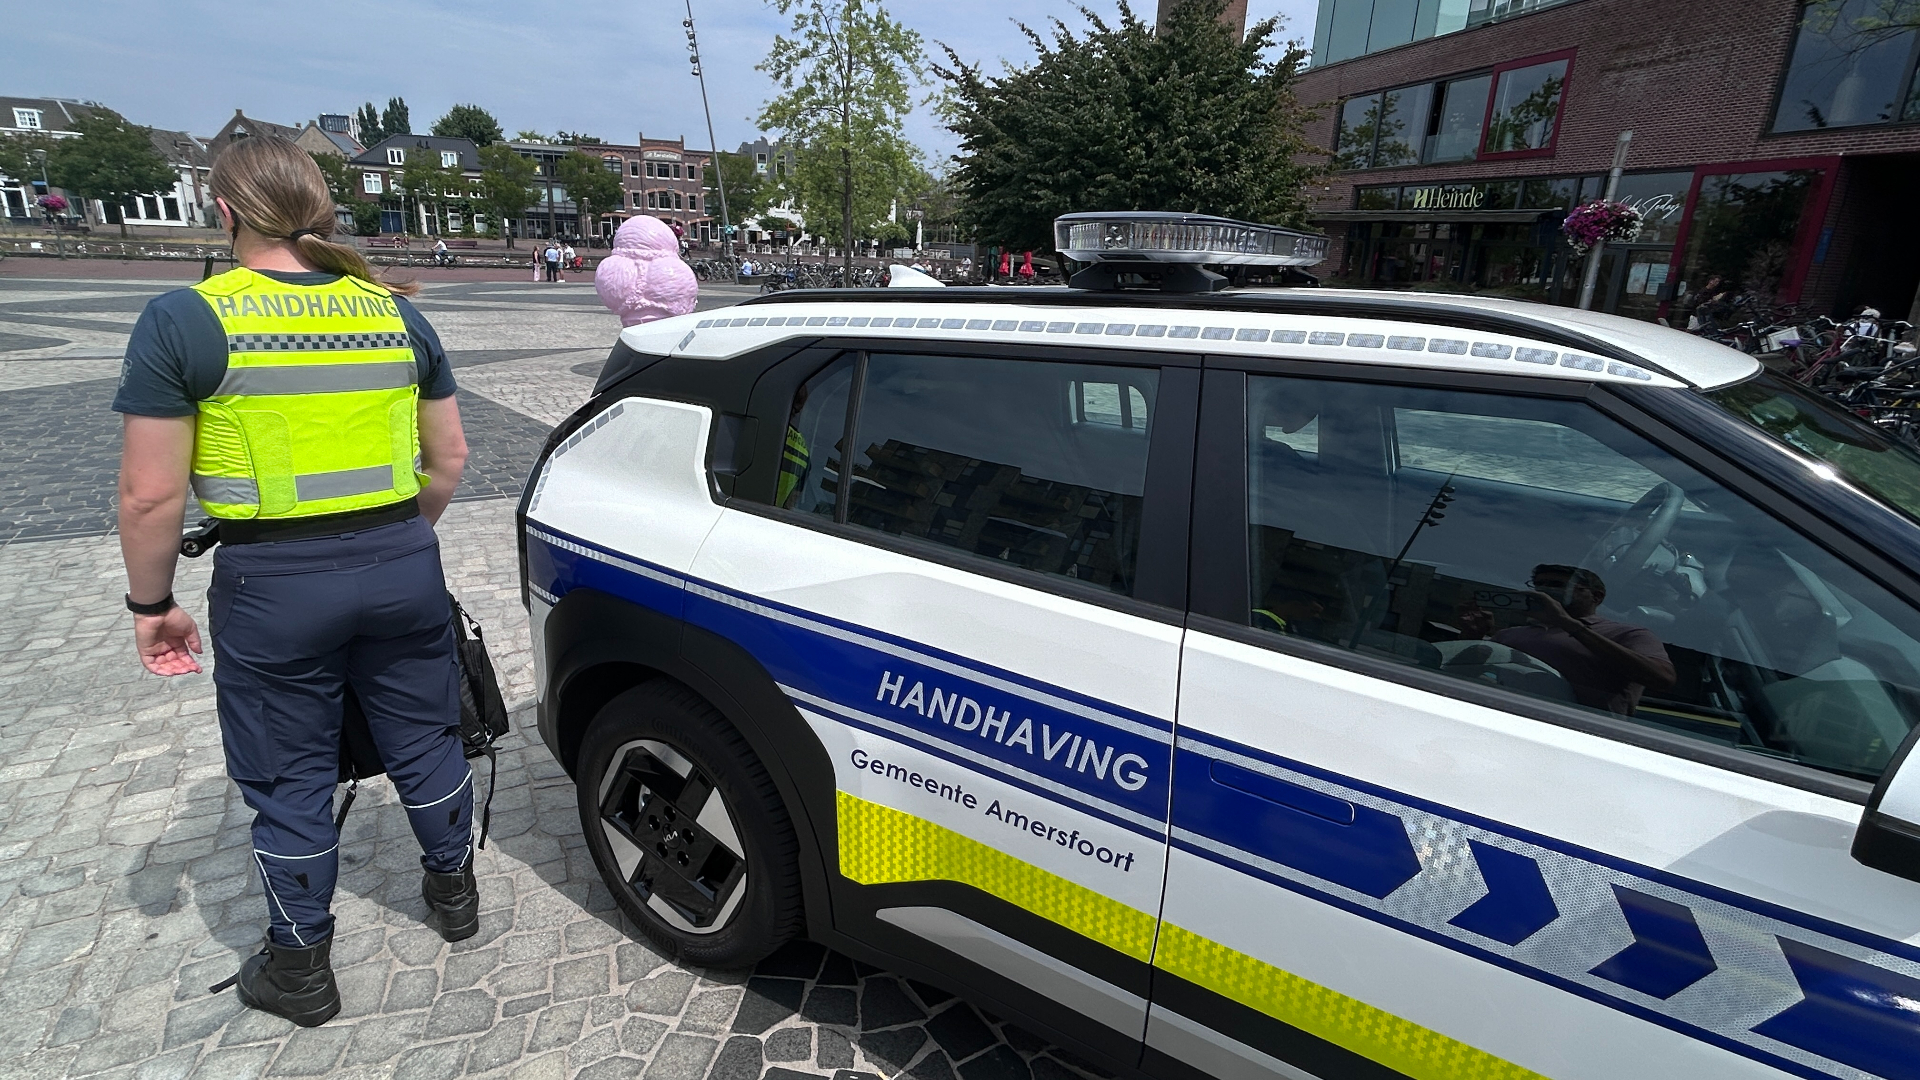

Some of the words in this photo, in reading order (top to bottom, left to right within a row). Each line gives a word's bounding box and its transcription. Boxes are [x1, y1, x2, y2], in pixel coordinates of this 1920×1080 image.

[1427, 186, 1484, 209] Heinde
[216, 294, 401, 318] HANDHAVING
[876, 670, 1149, 792] HANDHAVING
[850, 749, 978, 809] Gemeente
[985, 800, 1135, 872] Amersfoort
